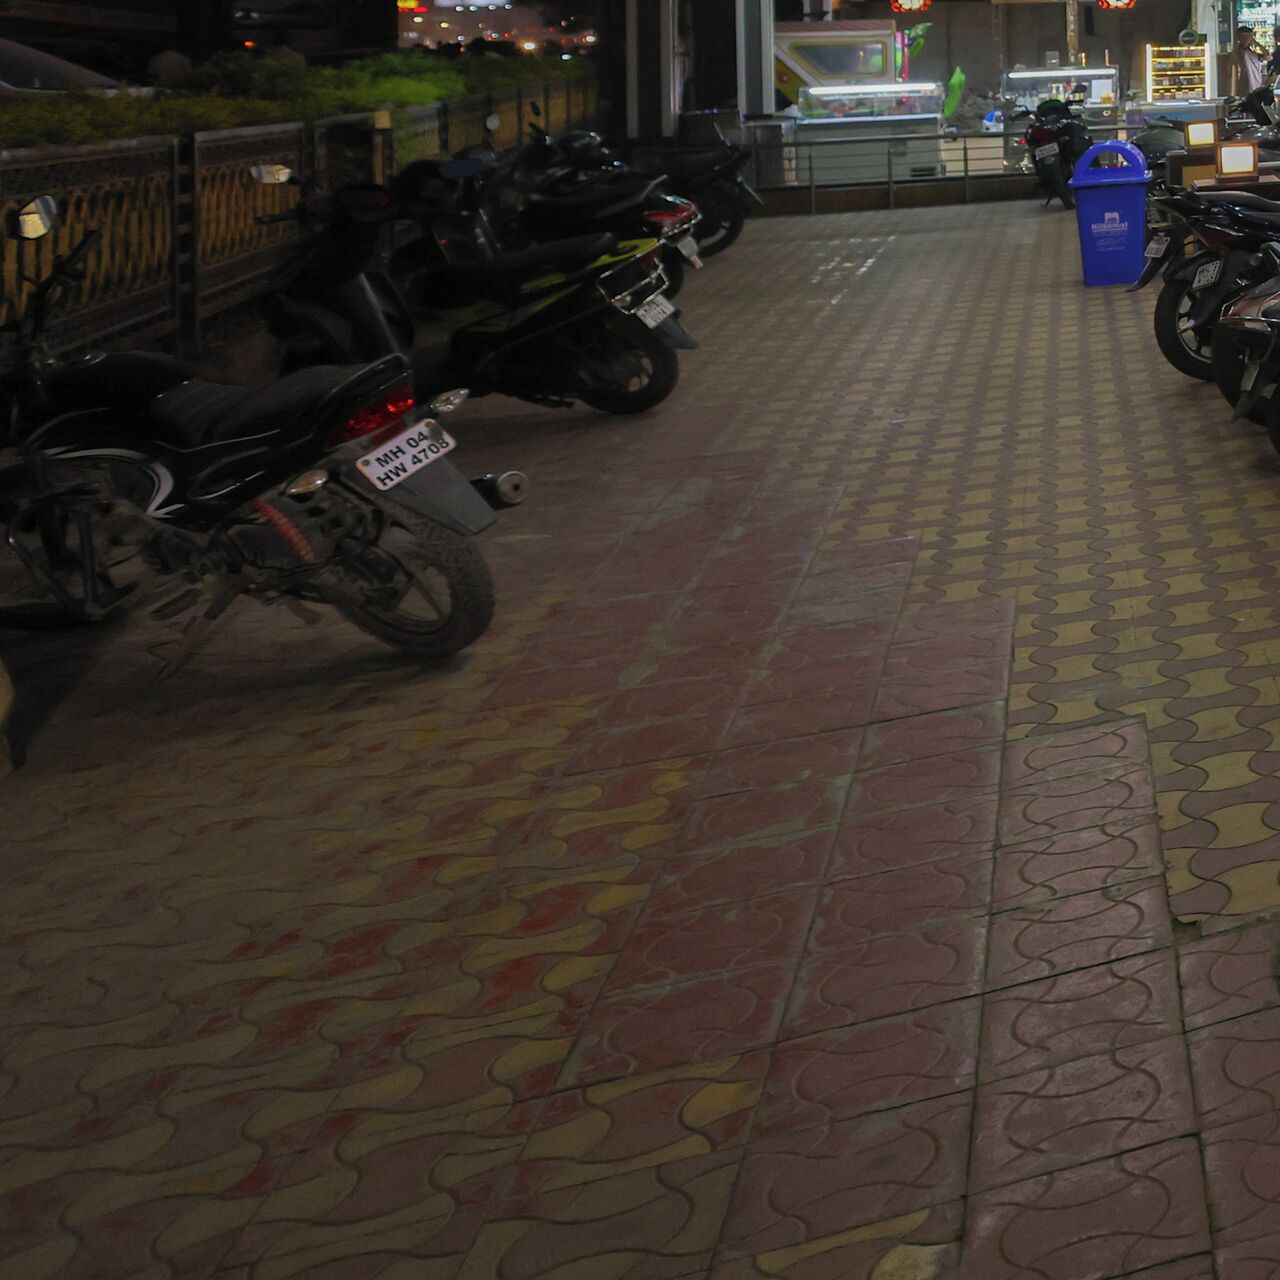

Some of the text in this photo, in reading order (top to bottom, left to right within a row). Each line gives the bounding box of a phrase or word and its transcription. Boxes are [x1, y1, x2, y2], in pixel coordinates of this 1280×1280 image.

[374, 431, 429, 468] MH 04
[376, 461, 408, 486] HW
